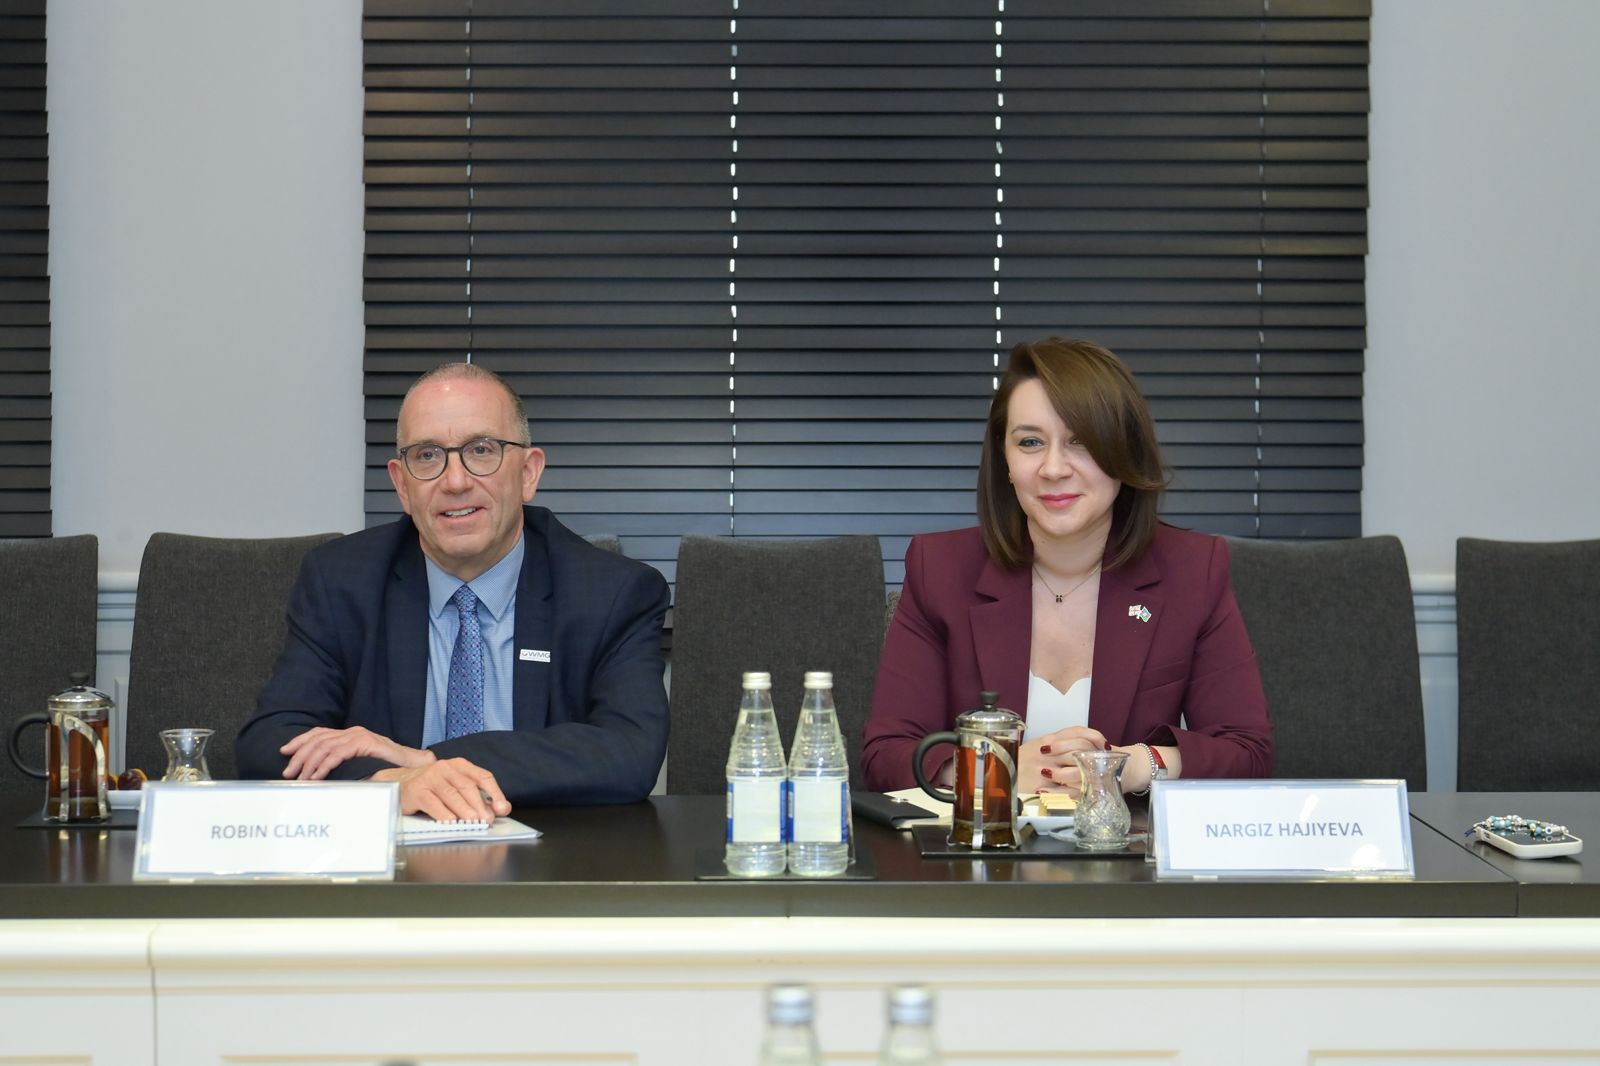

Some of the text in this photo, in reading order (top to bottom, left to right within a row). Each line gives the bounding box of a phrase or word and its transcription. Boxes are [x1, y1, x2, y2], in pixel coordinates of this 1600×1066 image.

[528, 651, 551, 659] WMG
[211, 823, 330, 839] ROBIN CLARK
[1205, 822, 1364, 838] NARGIZ HAJIYEVA
